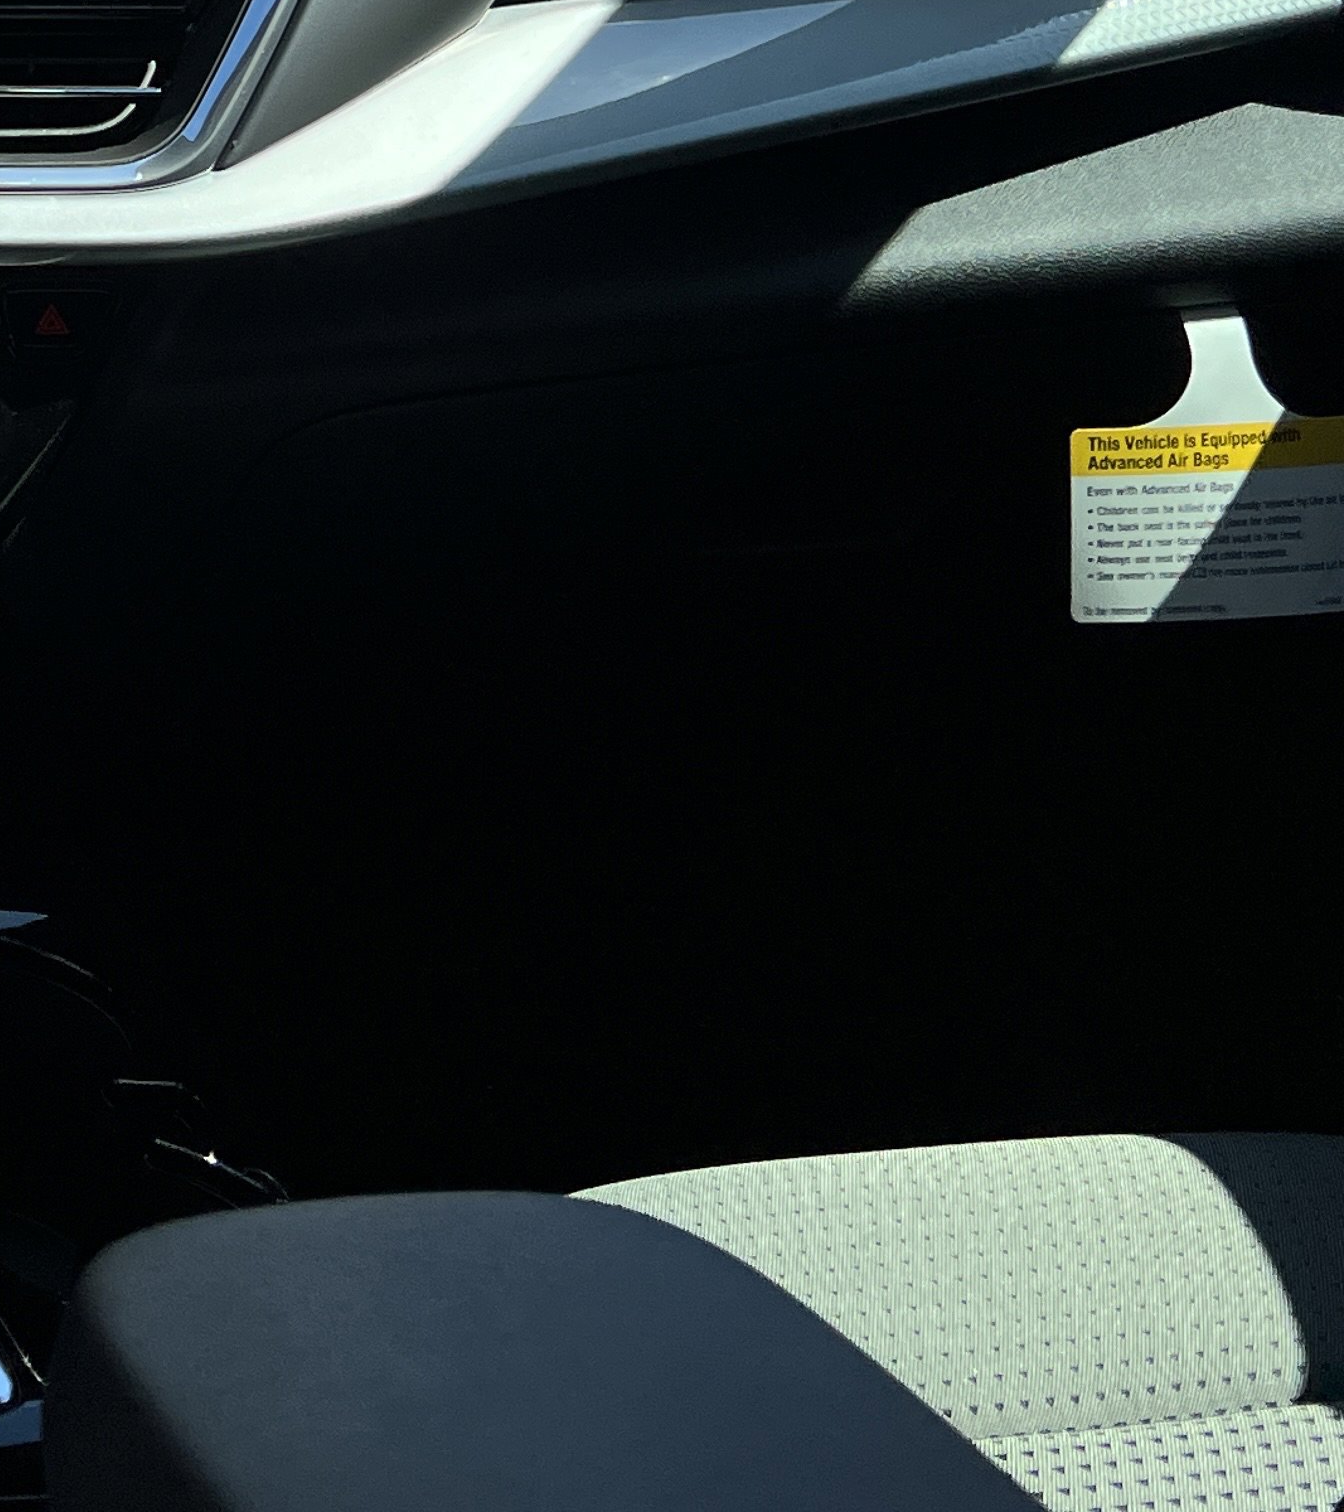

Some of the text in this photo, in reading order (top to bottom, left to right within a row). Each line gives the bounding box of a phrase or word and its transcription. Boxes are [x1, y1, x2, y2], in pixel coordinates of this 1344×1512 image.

[1088, 436, 1120, 452] This
[1125, 433, 1179, 450] Vehicle
[1184, 432, 1196, 448] is
[1201, 429, 1266, 450] Equipped
[1088, 450, 1229, 471] Advanced Air Bags
